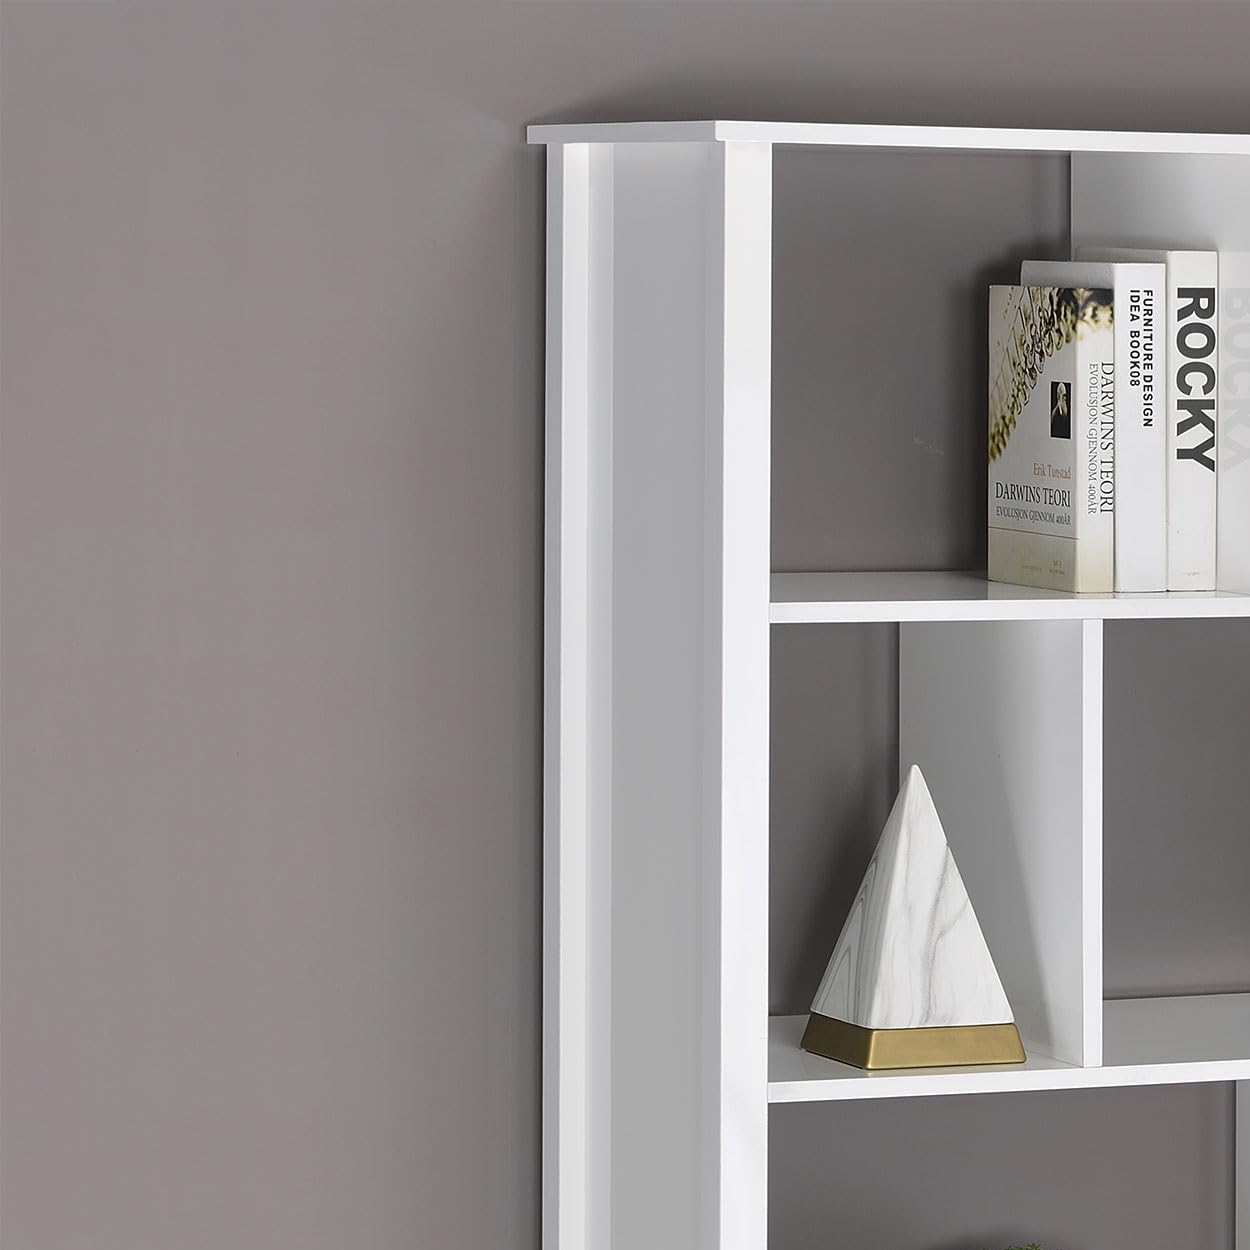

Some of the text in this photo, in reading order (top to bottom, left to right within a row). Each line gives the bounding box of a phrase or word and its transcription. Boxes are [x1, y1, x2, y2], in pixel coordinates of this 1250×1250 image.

[1129, 289, 1141, 387] IDEA BOOK08
[1143, 289, 1153, 427] FURNITURE DESIGN
[1087, 363, 1099, 425] EVOLUSJON
[1176, 287, 1217, 473] ROCKY
[1086, 428, 1098, 481] GJENNOM
[1099, 362, 1115, 514] DARWINS TEORI
[995, 482, 1071, 508] DARWINS TEORI
[1033, 463, 1071, 480] Erik Tunstad
[996, 506, 1029, 521] EVOLUSJON
[1028, 510, 1055, 524] GJENNOM
